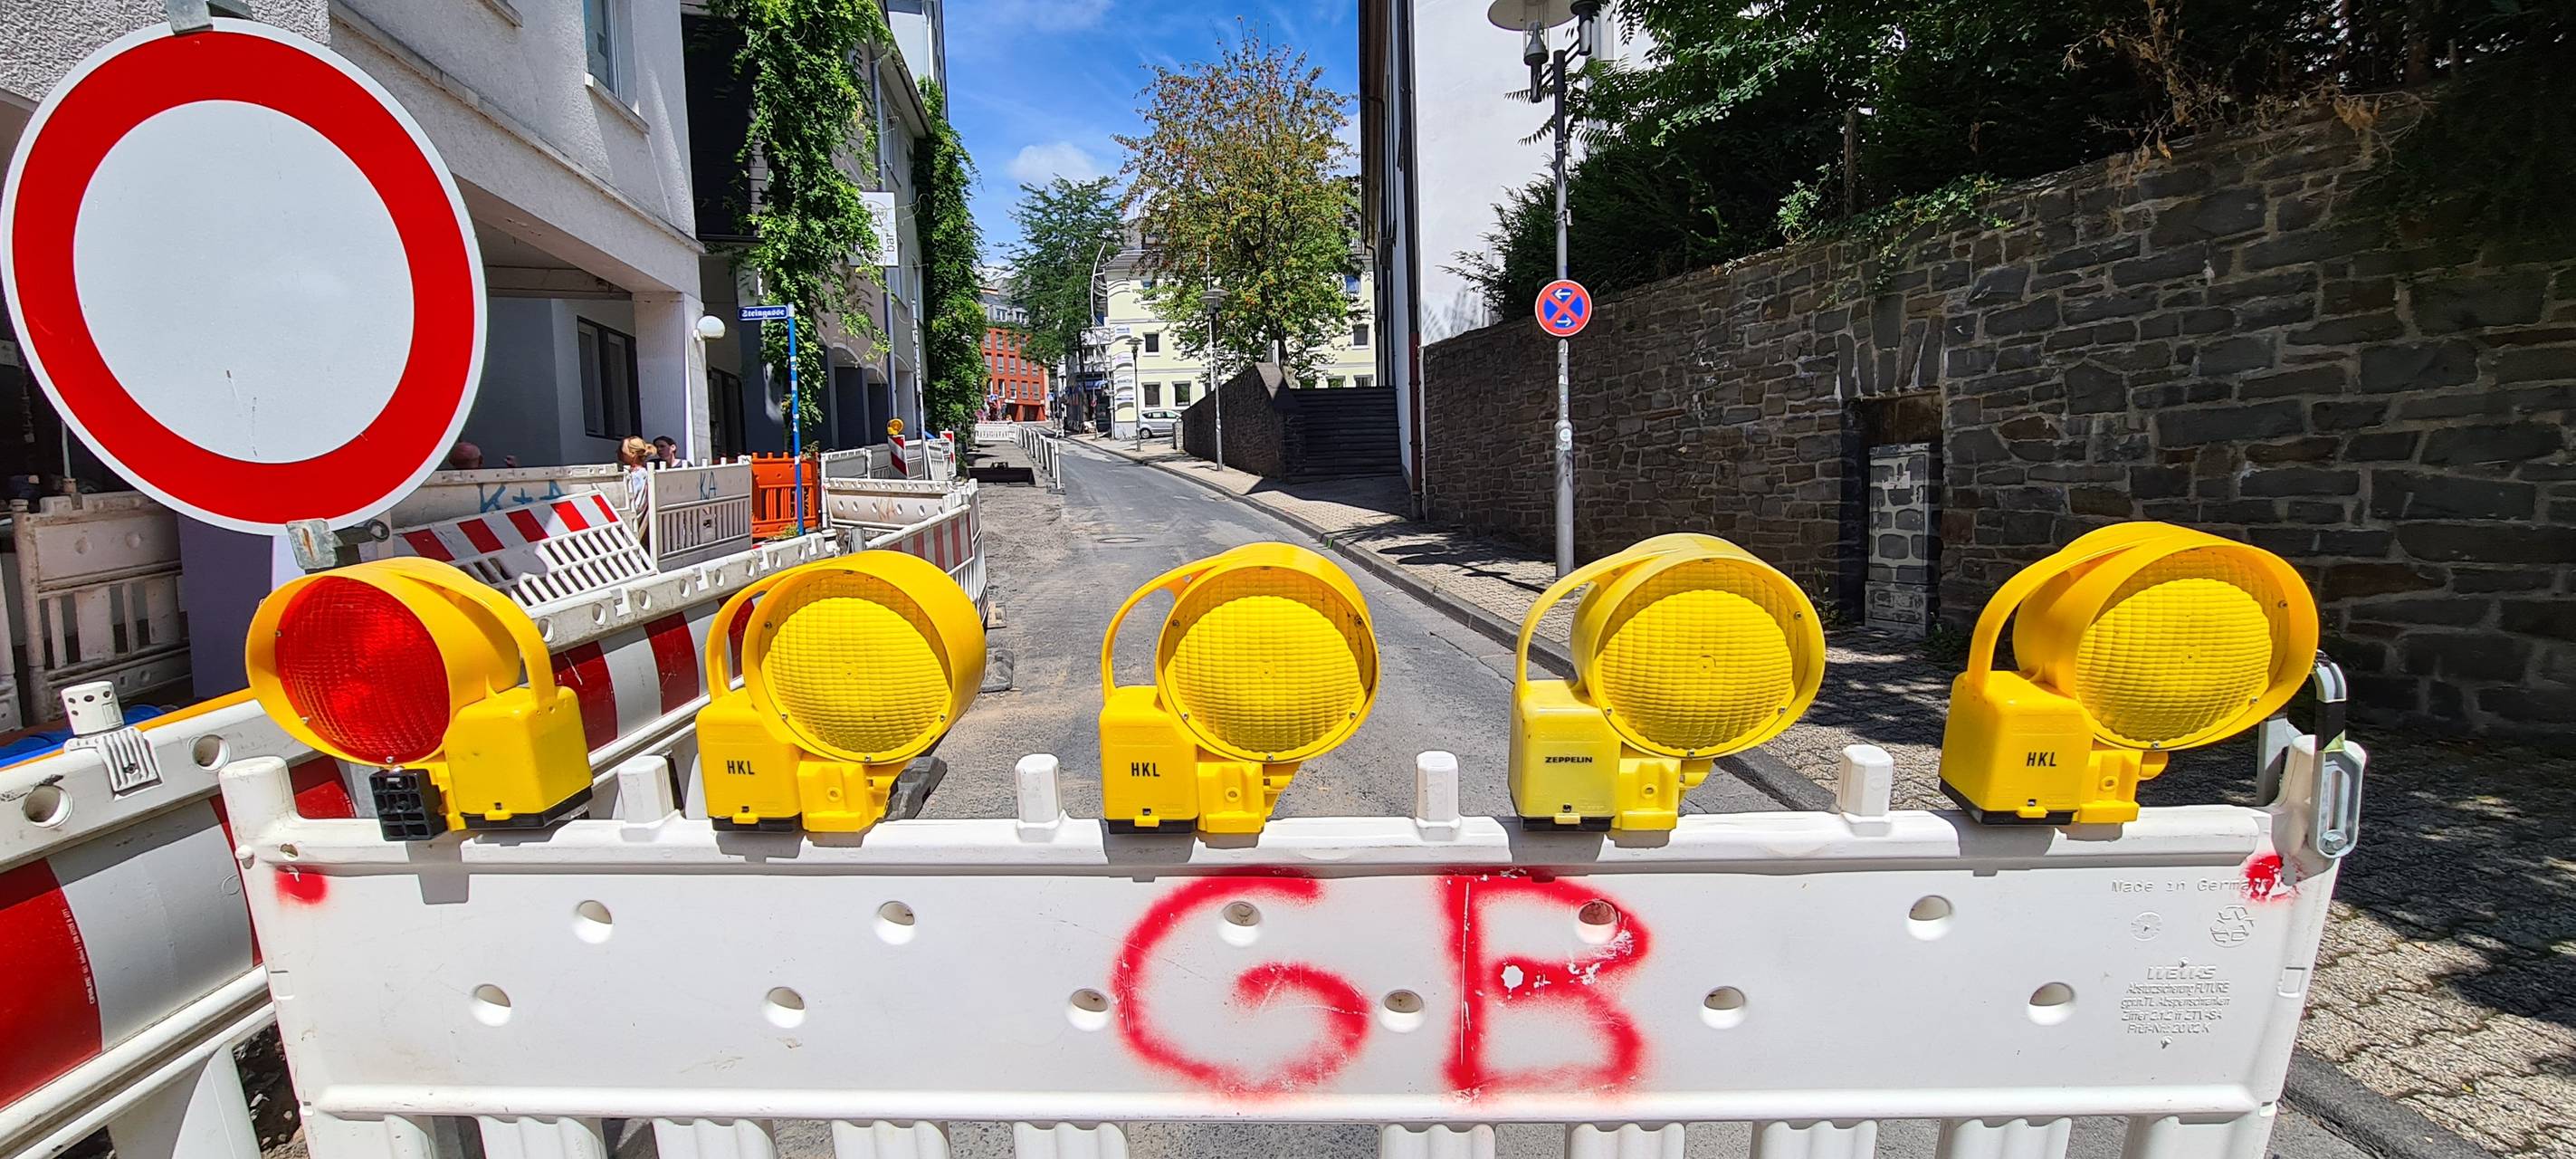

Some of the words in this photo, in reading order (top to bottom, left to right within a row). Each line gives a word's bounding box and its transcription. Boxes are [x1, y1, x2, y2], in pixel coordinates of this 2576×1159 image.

[885, 233, 895, 253] bar
[726, 760, 756, 775] HKL
[2026, 751, 2057, 768] HKL
[1131, 761, 1161, 778] HKL
[2112, 879, 2154, 893] Made
[2165, 879, 2186, 892] in
[2194, 980, 2229, 993] FUTURE
